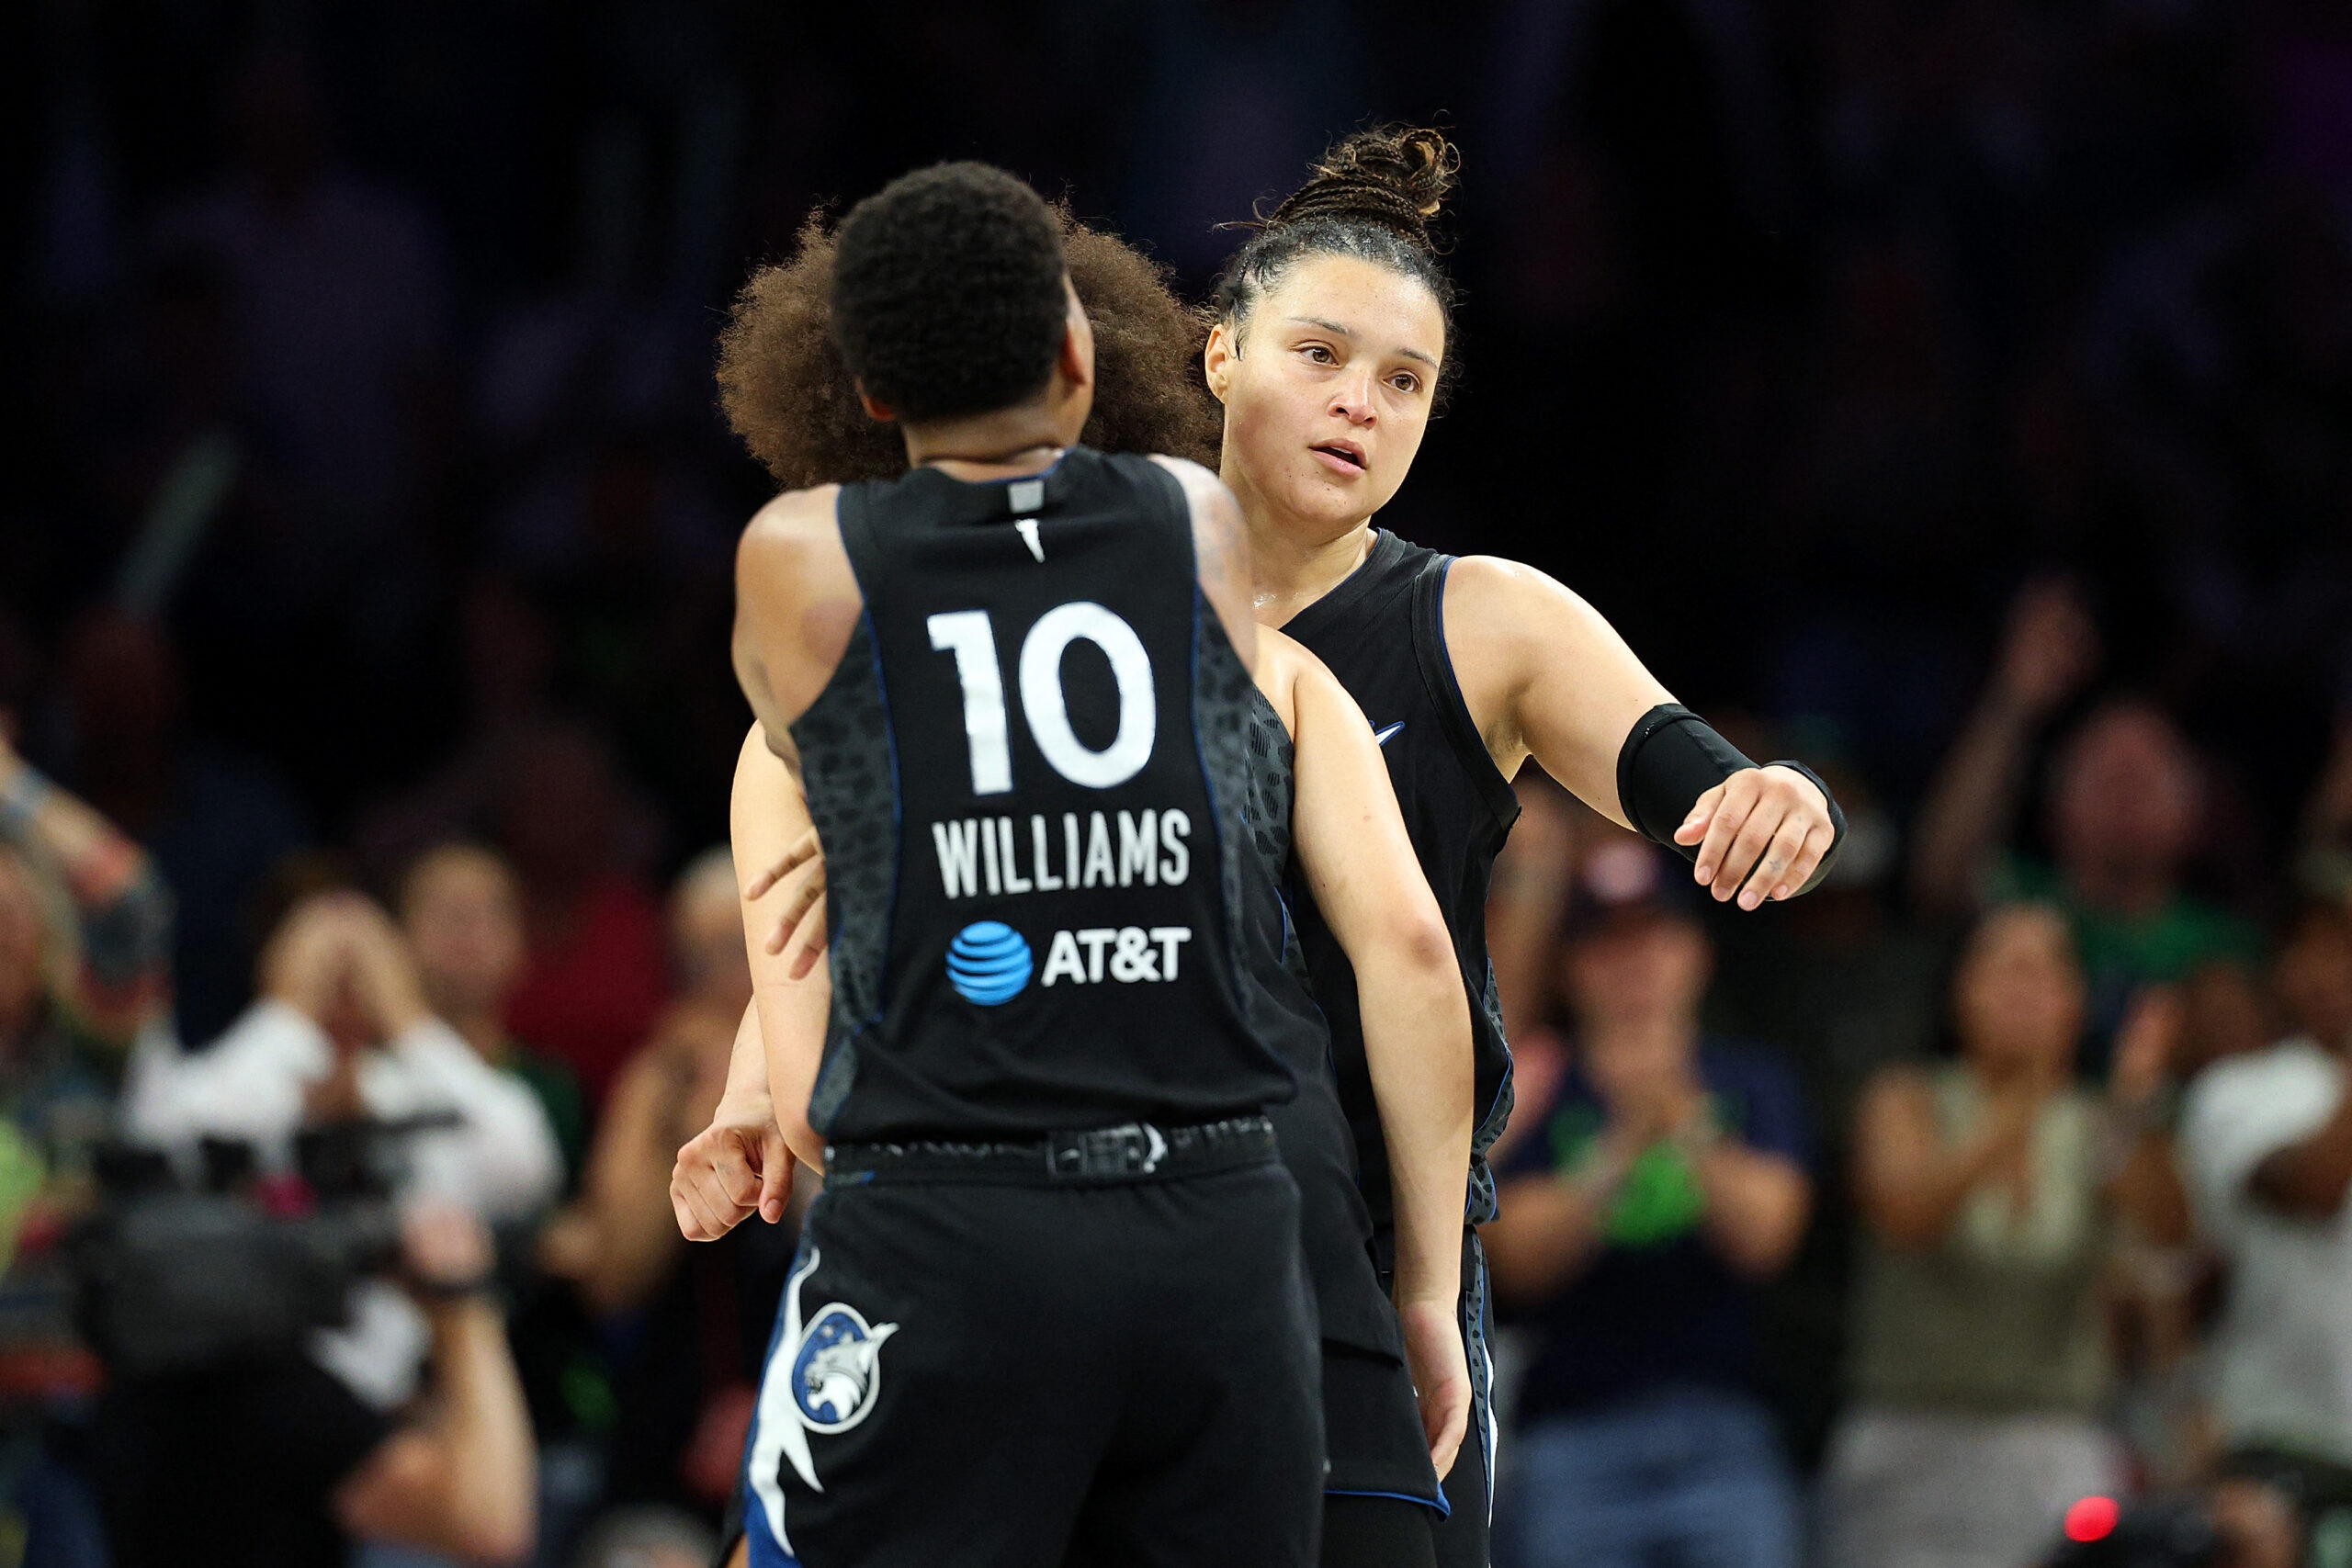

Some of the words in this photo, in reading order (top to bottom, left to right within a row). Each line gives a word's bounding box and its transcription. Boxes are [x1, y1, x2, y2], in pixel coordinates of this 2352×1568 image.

[926, 601, 1158, 796] 10
[931, 808, 1192, 898] WILLIAMS
[1041, 926, 1193, 987] AT&T
